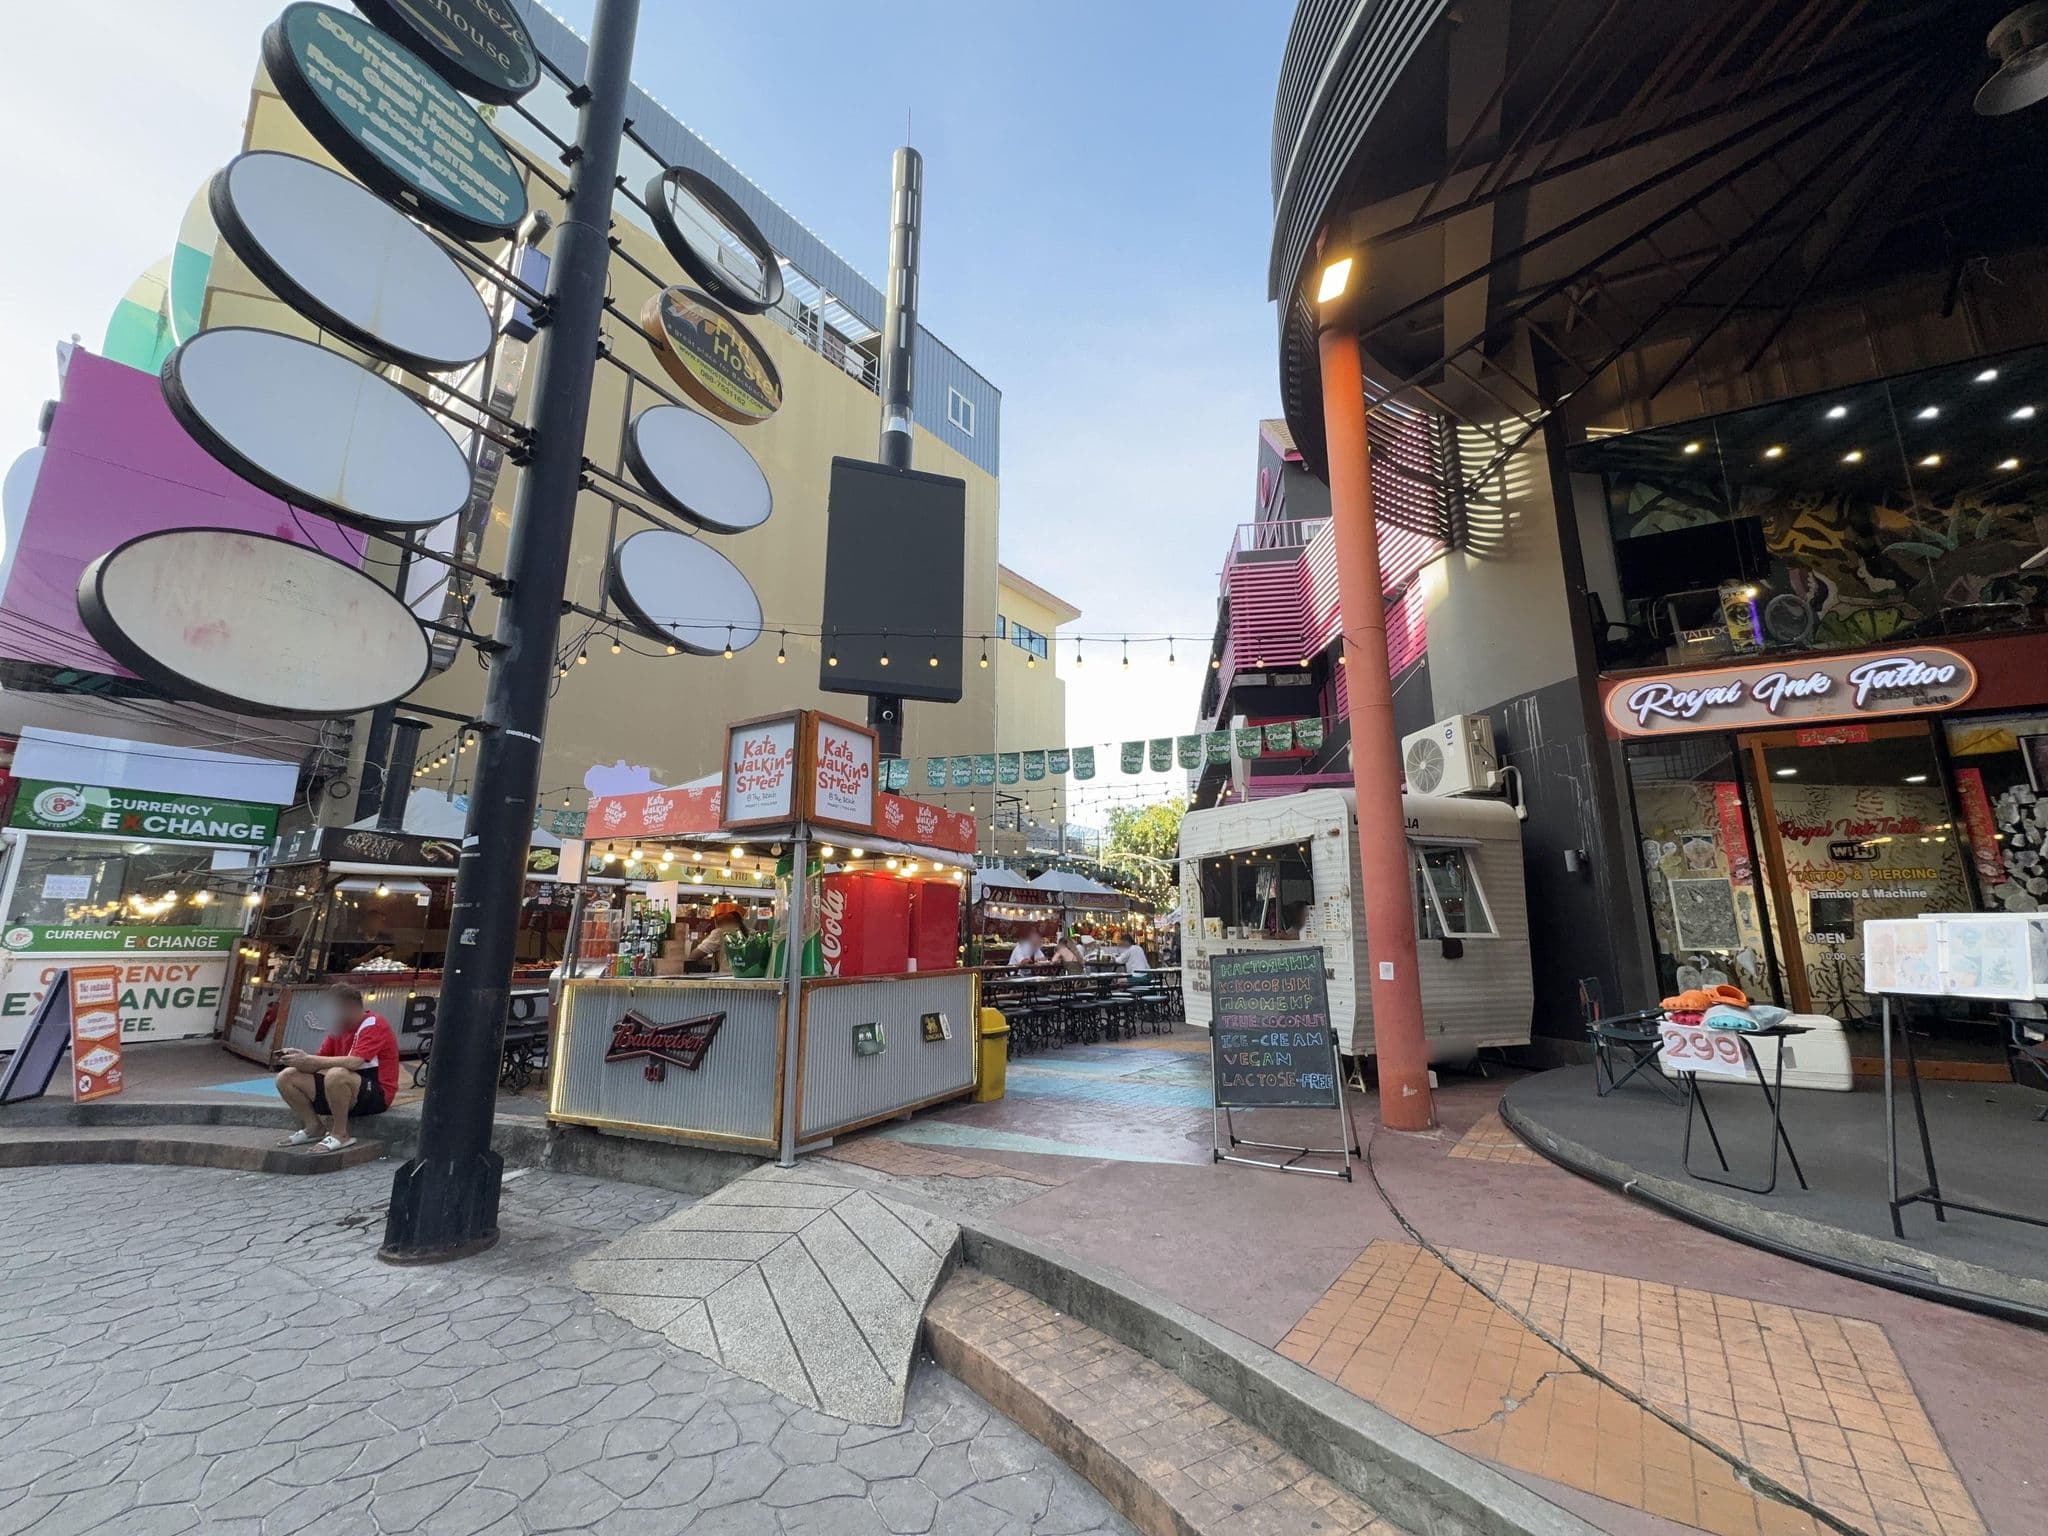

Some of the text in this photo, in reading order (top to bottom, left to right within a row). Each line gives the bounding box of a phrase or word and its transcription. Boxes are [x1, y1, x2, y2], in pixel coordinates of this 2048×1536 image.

[1628, 657, 1956, 727] Royal Ink Tattoo
[1267, 733, 1290, 741] Chang
[1298, 729, 1323, 738] Chang
[743, 734, 776, 759] Kata
[823, 736, 853, 763] Kata
[736, 770, 784, 793] Street
[818, 771, 861, 795] Street
[106, 798, 214, 817] CURRENCY
[648, 794, 665, 805] Kata
[101, 812, 266, 840] EXCHANGE
[643, 812, 669, 826] Street
[1779, 819, 1834, 846] Royal
[1794, 868, 1938, 881] TATTOO & PIERCING
[1810, 888, 1927, 899] Bamboo & Machine
[45, 930, 120, 940] CURRENCY
[124, 935, 219, 948] EXCHANGE
[1806, 933, 1846, 944] OPEN
[40, 965, 200, 986] CRENCY
[1222, 1013, 1326, 1028] TRUE COCONUT
[612, 1022, 706, 1052] Budweiser
[1664, 1030, 1739, 1064] 299
[1224, 1052, 1292, 1066] VEGAN
[1222, 1072, 1334, 1089] LACTOSE-FREE
